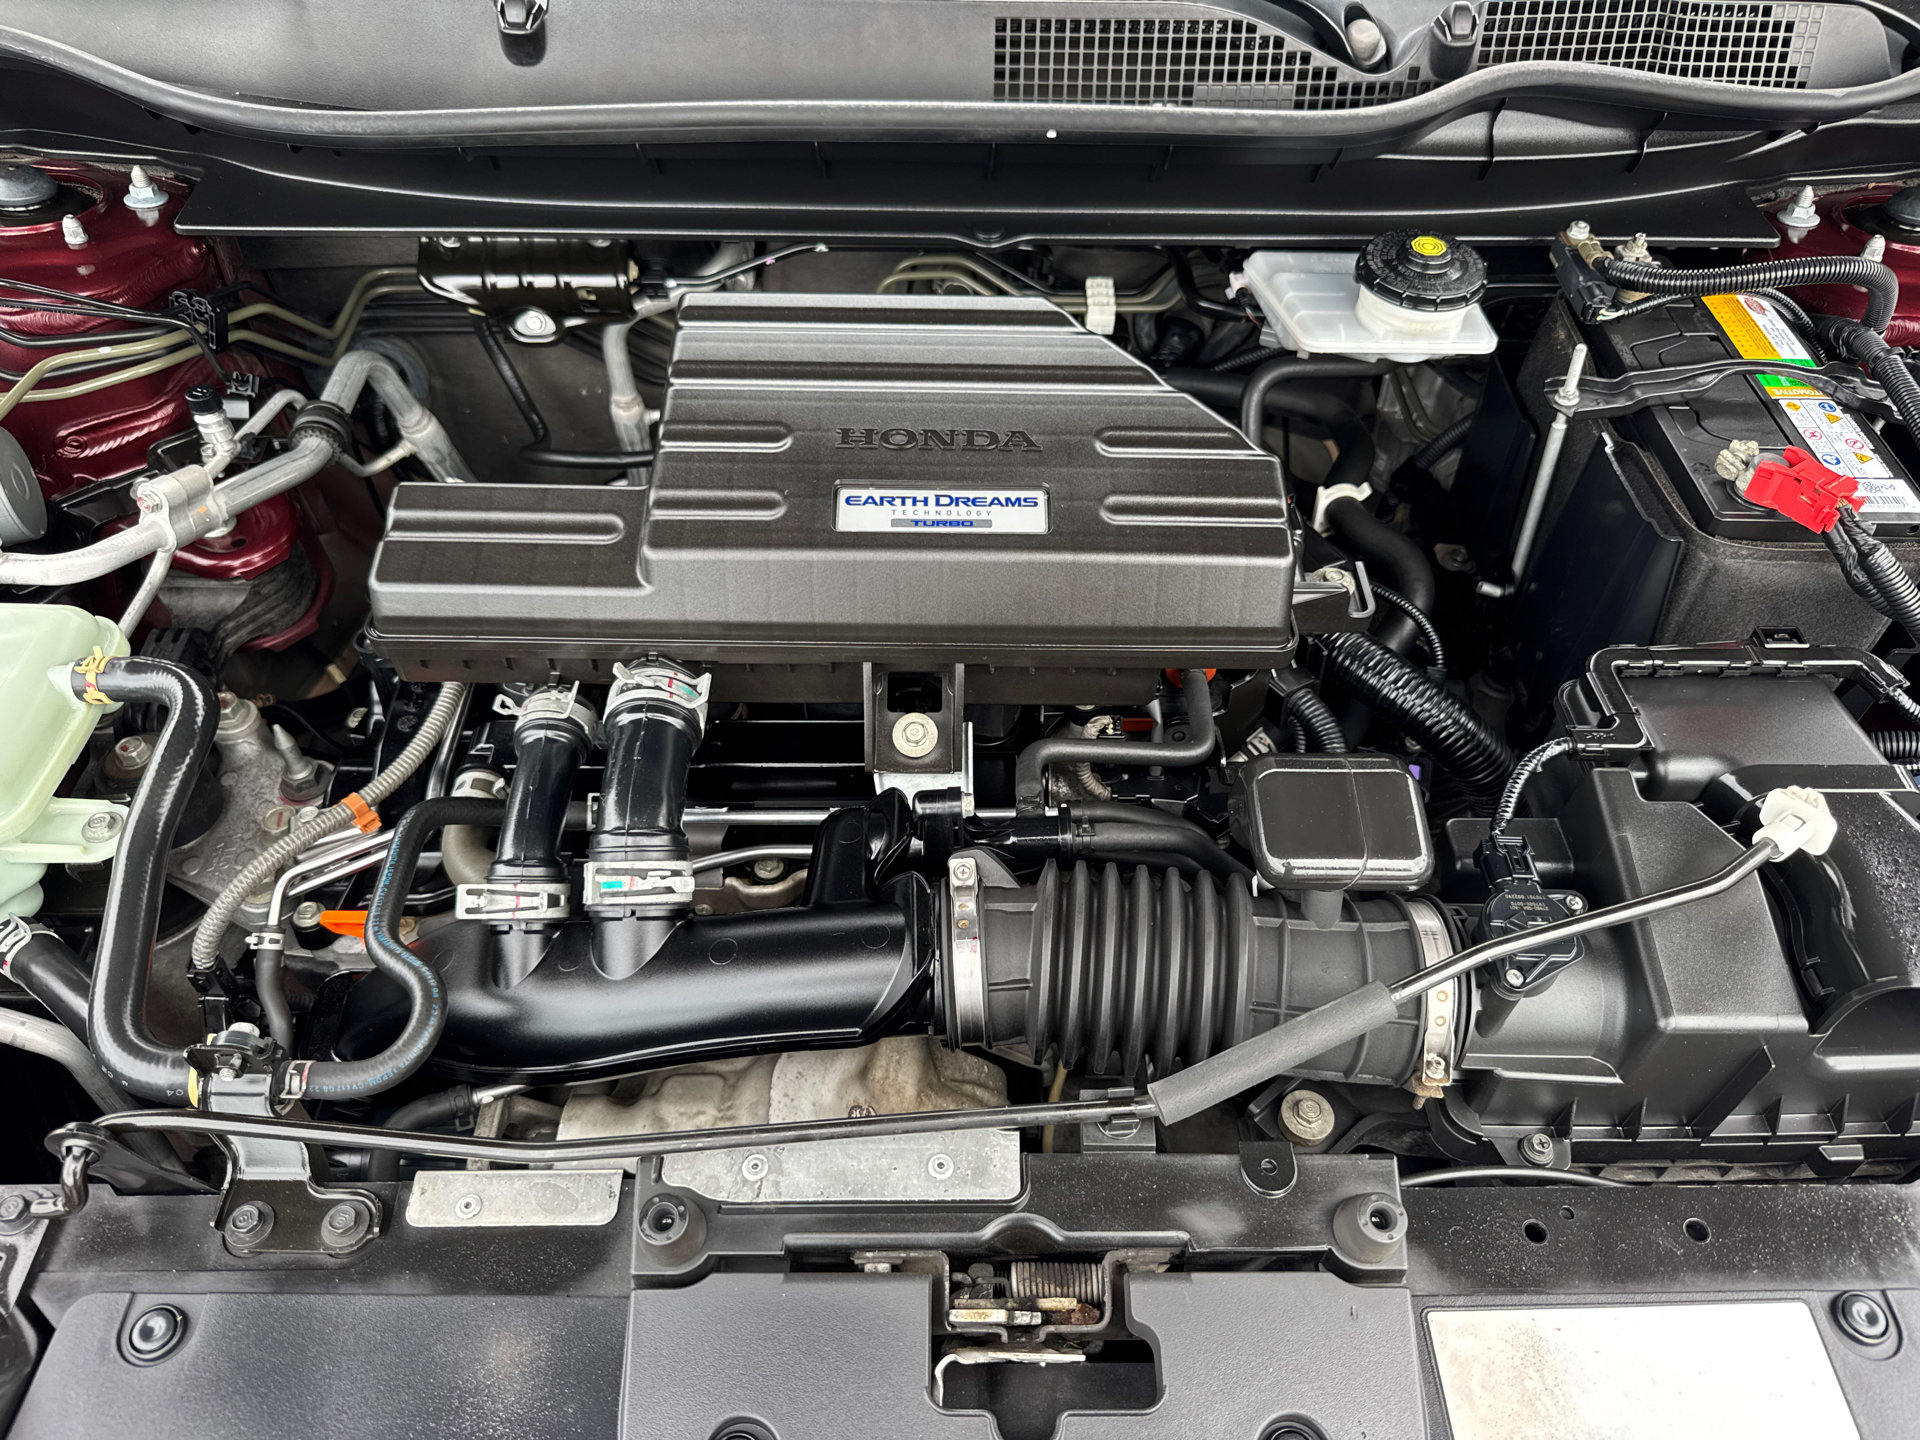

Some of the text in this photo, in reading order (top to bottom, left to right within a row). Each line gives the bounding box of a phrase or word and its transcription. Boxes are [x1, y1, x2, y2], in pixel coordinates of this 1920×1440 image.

[834, 427, 1044, 452] HONDA
[844, 494, 1039, 508] EARTH DREAMS
[891, 509, 992, 517] TECHNOLOGY
